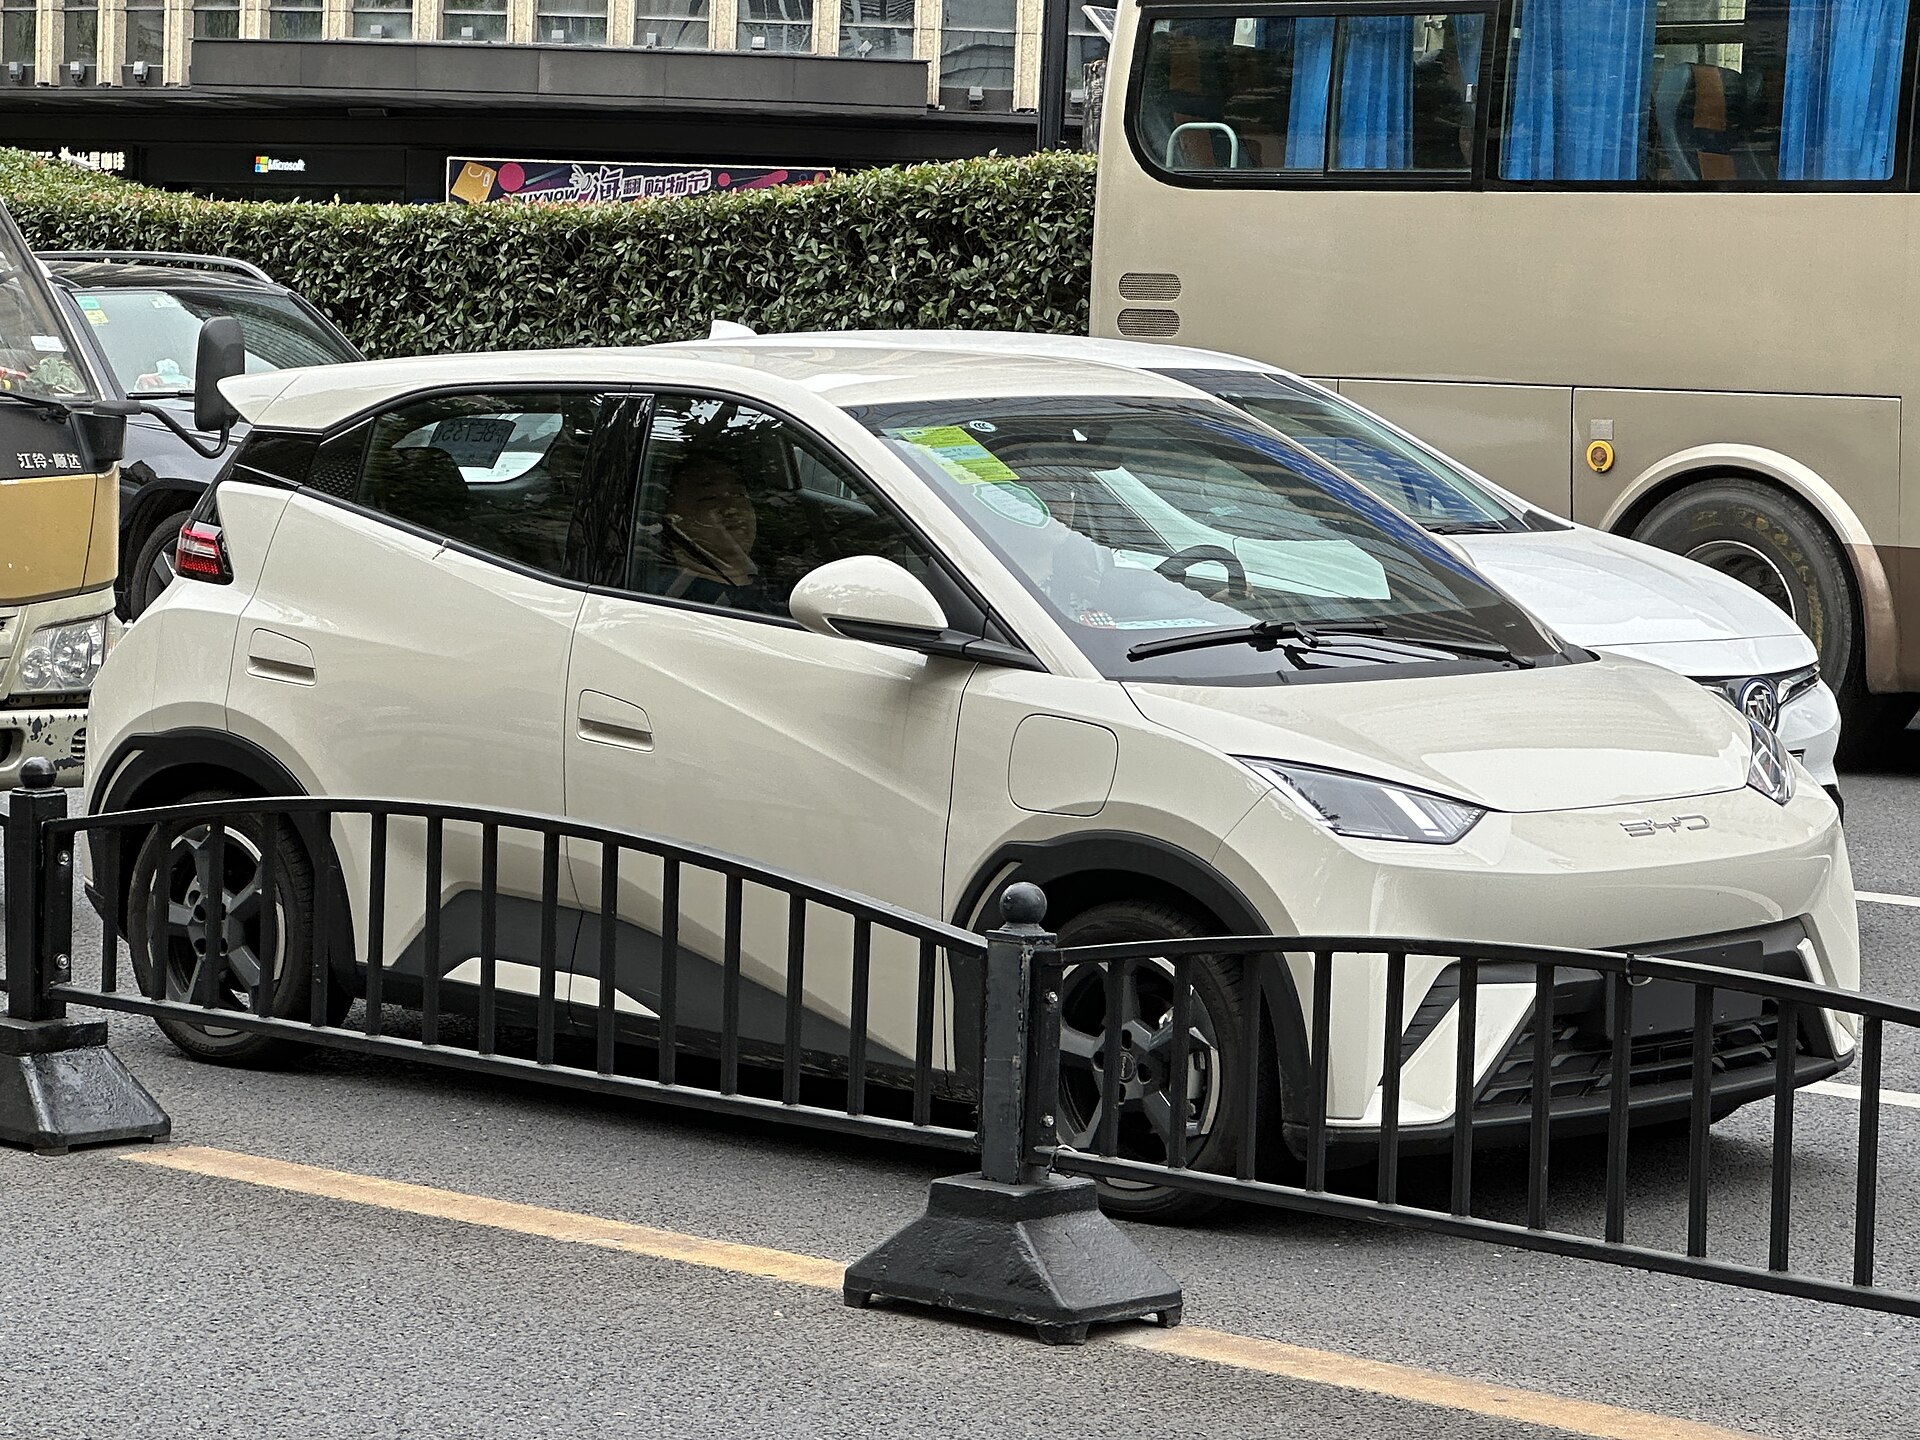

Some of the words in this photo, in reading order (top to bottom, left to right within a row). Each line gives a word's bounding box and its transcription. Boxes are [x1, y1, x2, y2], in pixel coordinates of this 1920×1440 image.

[268, 158, 306, 171] Microsoft
[514, 187, 580, 202] UYNOW
[16, 452, 82, 469] 江铃·顺达
[1619, 814, 1710, 838] BYD
